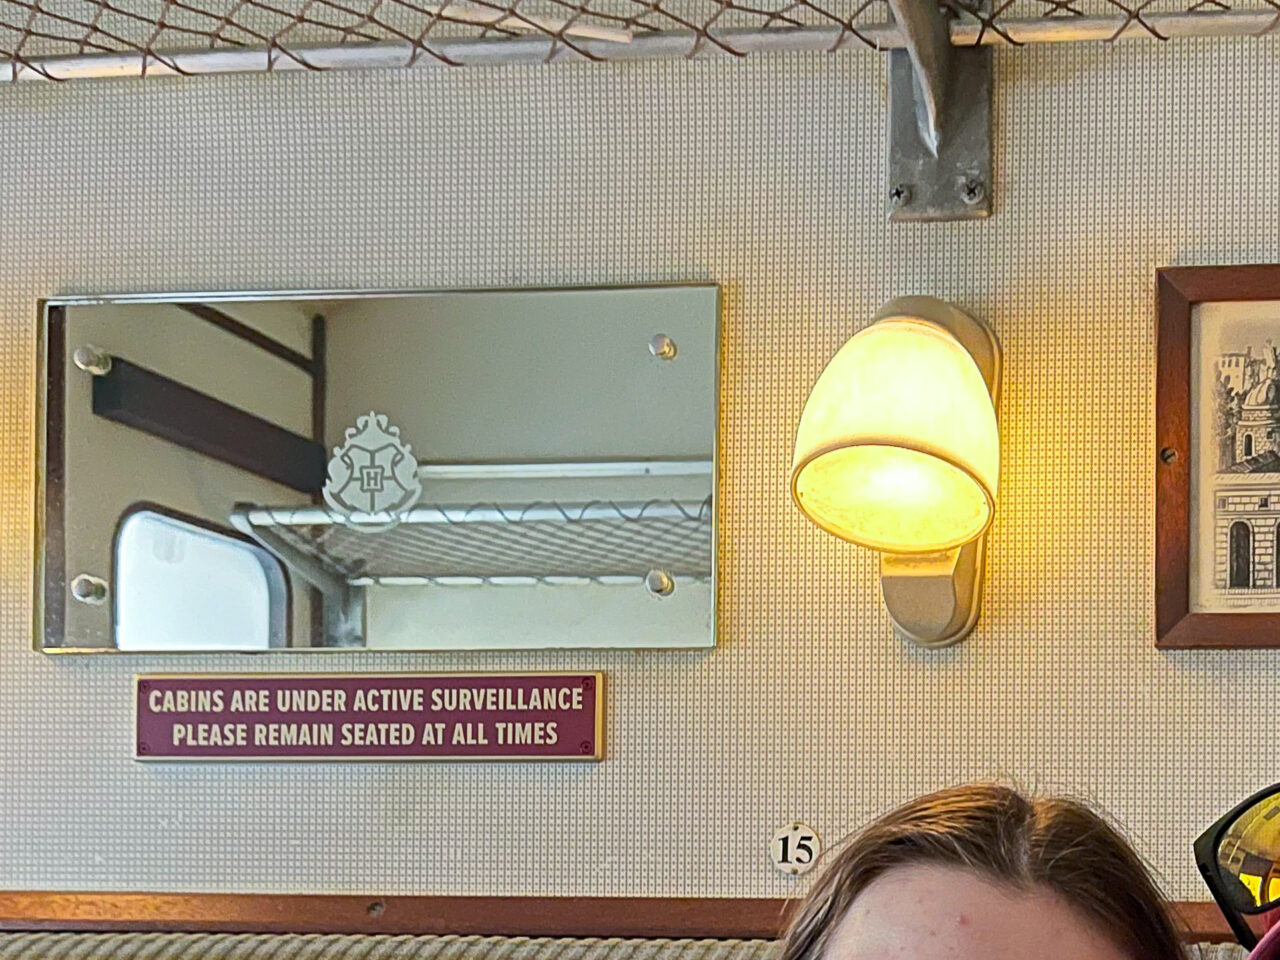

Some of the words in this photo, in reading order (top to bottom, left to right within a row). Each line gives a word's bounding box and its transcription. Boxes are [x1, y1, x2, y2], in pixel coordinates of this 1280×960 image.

[149, 690, 224, 713] CABINS
[230, 690, 270, 712] ARE
[277, 689, 347, 712] UNDER
[353, 689, 424, 711] ACTIVE
[431, 687, 583, 710] SURVEILLANCE
[172, 723, 248, 746] PLEASE
[254, 723, 334, 745] REMAIN
[341, 723, 415, 745] SEATED
[422, 723, 446, 745] AT
[452, 723, 489, 745] ALL
[495, 722, 558, 744] TIMES
[777, 835, 814, 864] 15
